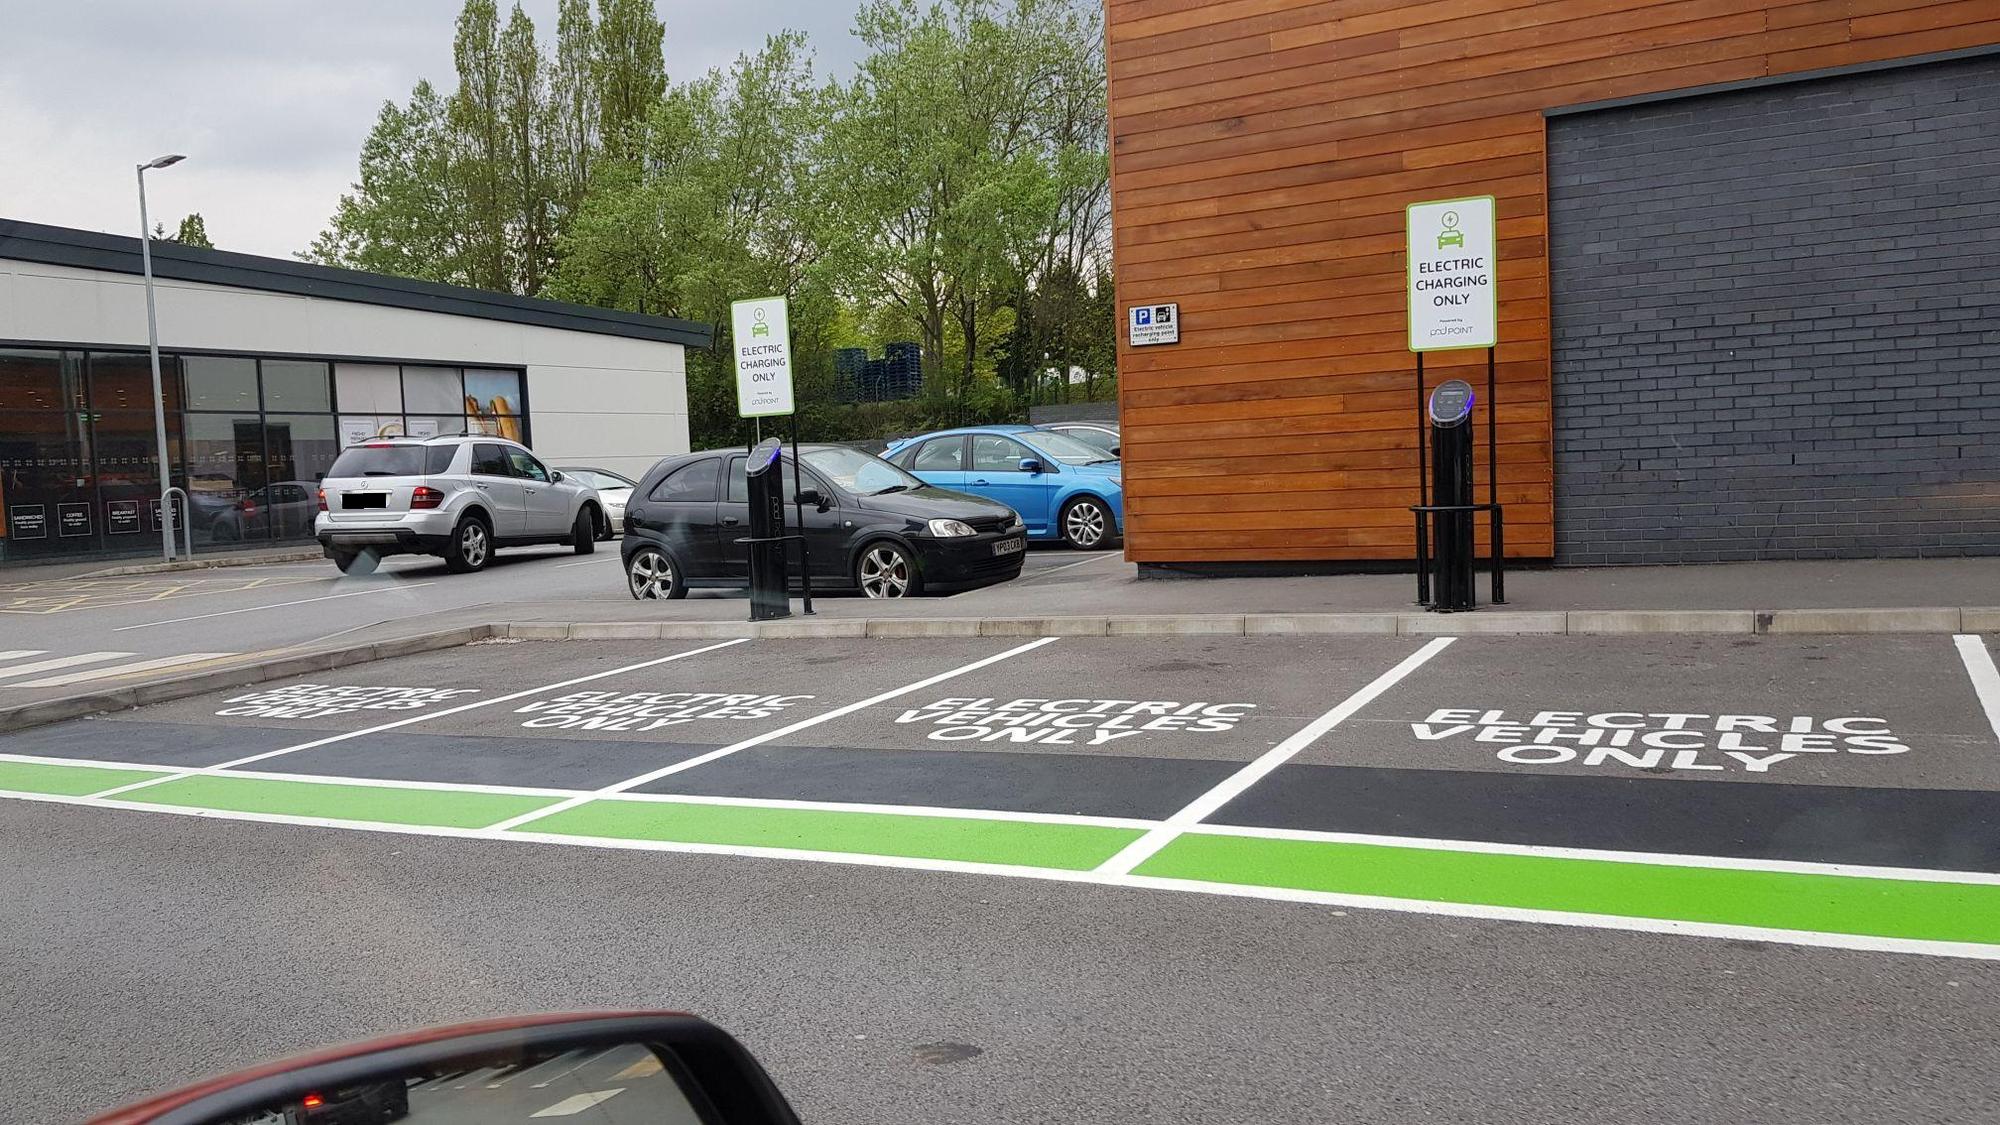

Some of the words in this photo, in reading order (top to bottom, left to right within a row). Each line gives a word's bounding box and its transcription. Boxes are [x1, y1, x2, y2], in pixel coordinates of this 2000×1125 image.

[1419, 257, 1484, 274] ELECTRIC
[1415, 274, 1488, 291] CHARGING
[1433, 293, 1470, 307] ONLY
[1138, 310, 1148, 324] P
[741, 344, 783, 356] ELECTRIC
[740, 358, 786, 370] CHARGING
[752, 372, 776, 383] ONLY
[550, 691, 815, 707] ELECTRIC
[921, 697, 1257, 717] ELECTRIC
[215, 705, 359, 719] ONLY
[513, 701, 784, 719] VEHICLES
[521, 715, 695, 732] ONLY
[894, 710, 1239, 732] VEHICLES
[1424, 708, 1892, 735] ELECTRIC
[927, 725, 1144, 745] ONLY
[1411, 723, 1910, 755] VEHICLES
[1496, 744, 1797, 772] ONLY
